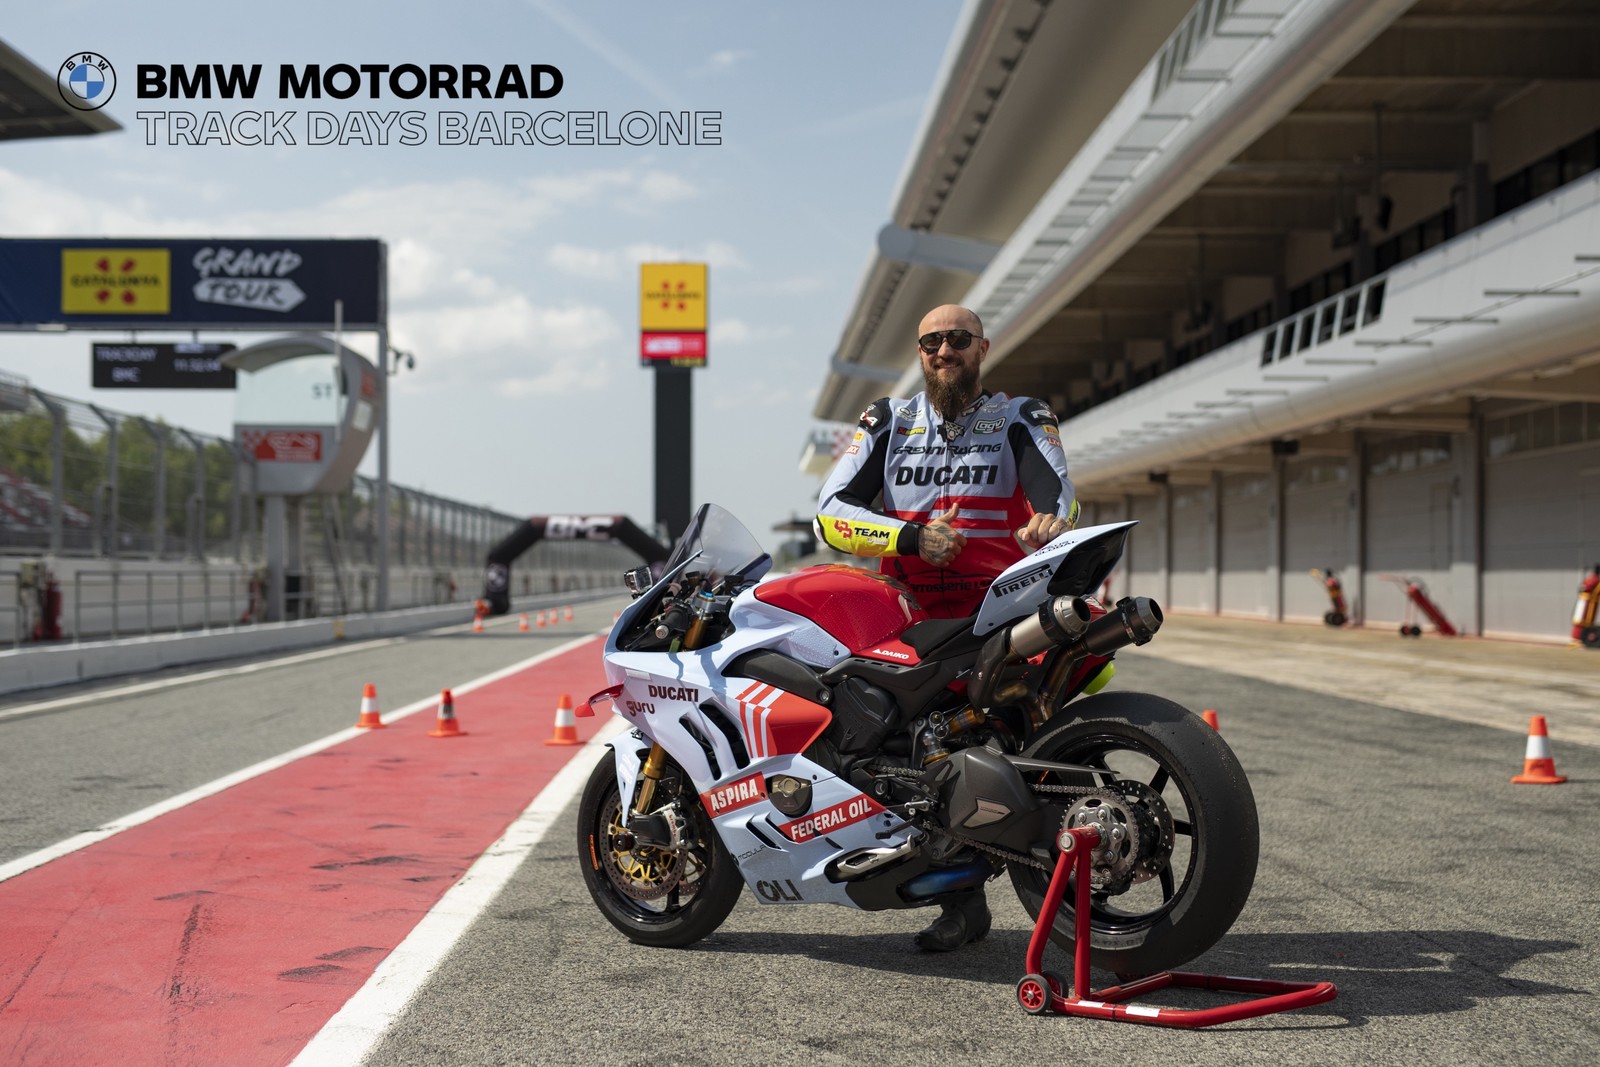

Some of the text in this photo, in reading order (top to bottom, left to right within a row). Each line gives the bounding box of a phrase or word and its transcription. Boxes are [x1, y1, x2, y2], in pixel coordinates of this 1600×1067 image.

[192, 246, 302, 277] GRAND
[207, 282, 284, 306] TOUR
[895, 465, 998, 486] DUCATI
[854, 527, 890, 538] TEAM
[992, 563, 1054, 598] PIRELLI
[648, 684, 699, 702] DUCATI
[710, 778, 758, 812] ASPIRA
[790, 798, 872, 840] FEDERAL OIL
